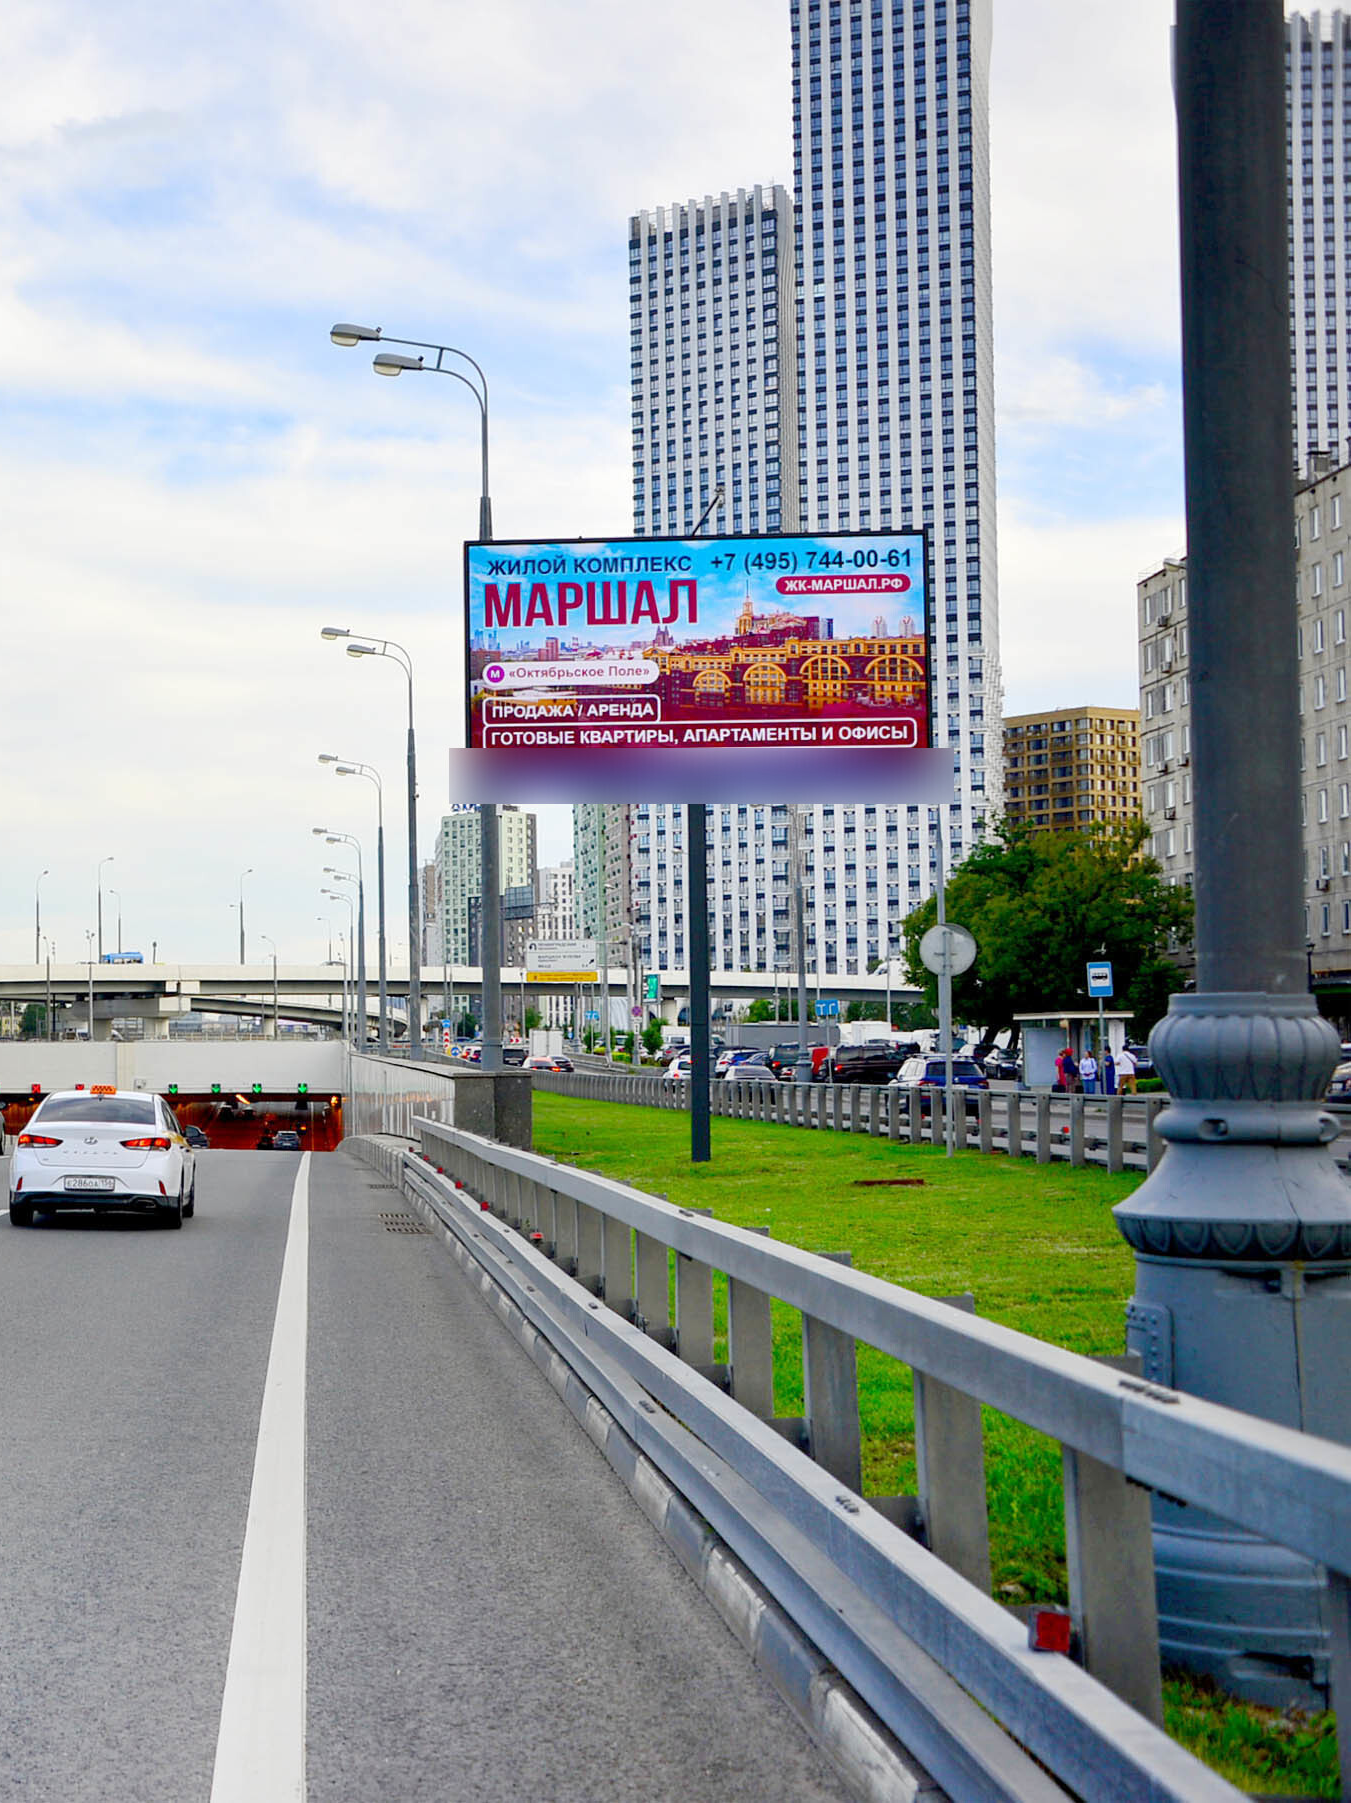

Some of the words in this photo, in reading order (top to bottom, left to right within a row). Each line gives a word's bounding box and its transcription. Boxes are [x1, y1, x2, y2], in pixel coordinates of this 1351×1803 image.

[487, 555, 566, 576] ЖИЛОЙ
[573, 556, 692, 574] КОМПЛЕКС
[710, 553, 736, 571] +7
[744, 551, 798, 575] (495)
[805, 549, 911, 570] 744-00-61
[784, 577, 903, 592] ЖК-МАРШАЛ.РФ
[484, 579, 698, 628] МАРШАЛ
[509, 667, 604, 681] «Октябрьское
[608, 665, 650, 678] Поле»
[492, 704, 574, 720] ПРОДАЖА
[587, 702, 655, 718] АРЕНДА
[491, 730, 575, 746] ГОТОВЫЕ
[580, 729, 678, 746] КВАРТИРЫ,
[683, 726, 817, 743] АПАРТАМЕНТЫ
[822, 726, 834, 740] И
[838, 725, 908, 741] ОФИСЫ
